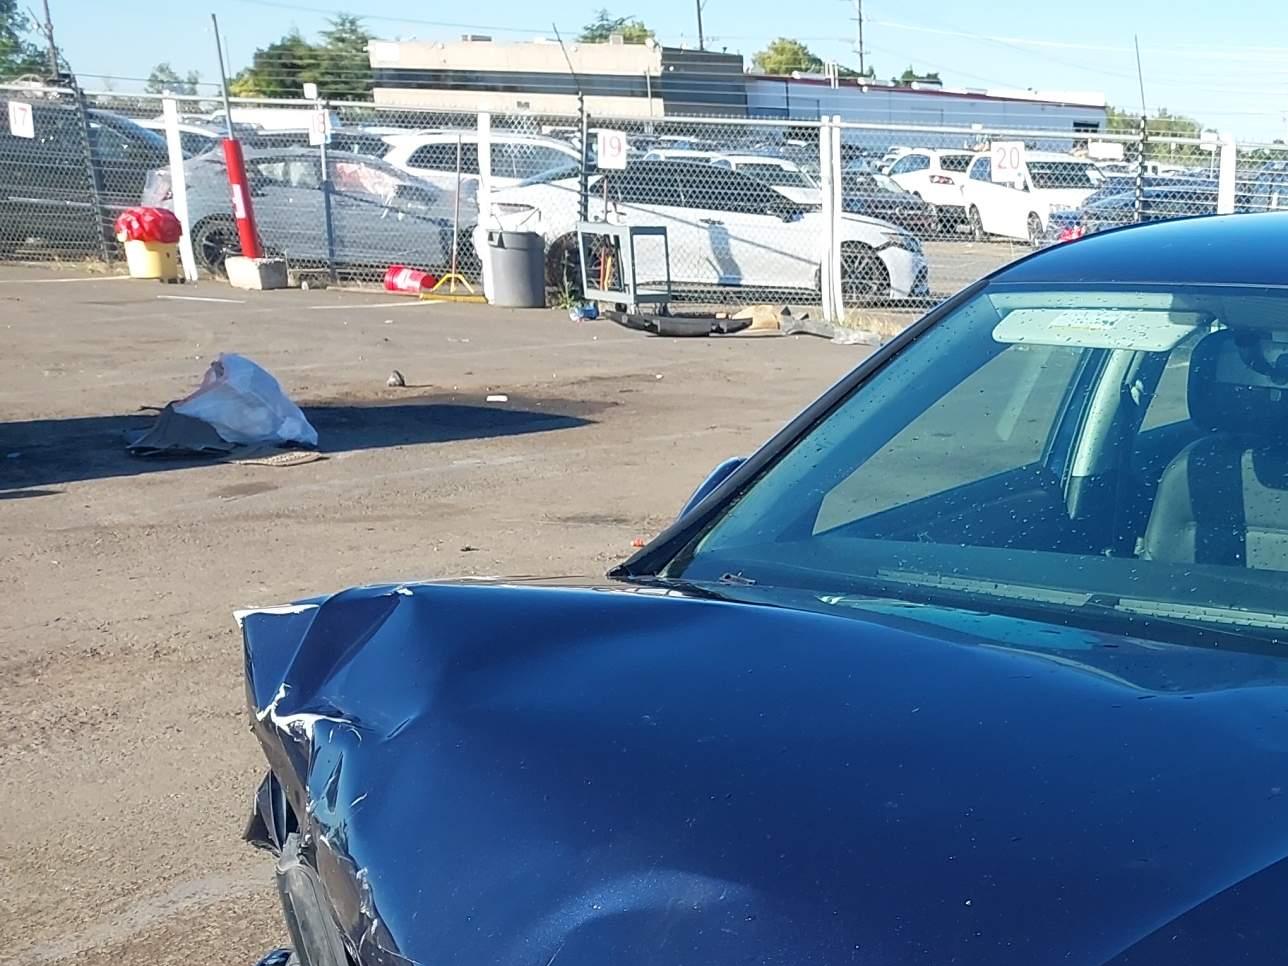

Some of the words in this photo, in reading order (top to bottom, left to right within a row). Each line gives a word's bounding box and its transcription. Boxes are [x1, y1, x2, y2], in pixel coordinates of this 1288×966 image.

[13, 103, 28, 126] 17
[602, 135, 622, 158] 19
[996, 146, 1020, 170] 20
